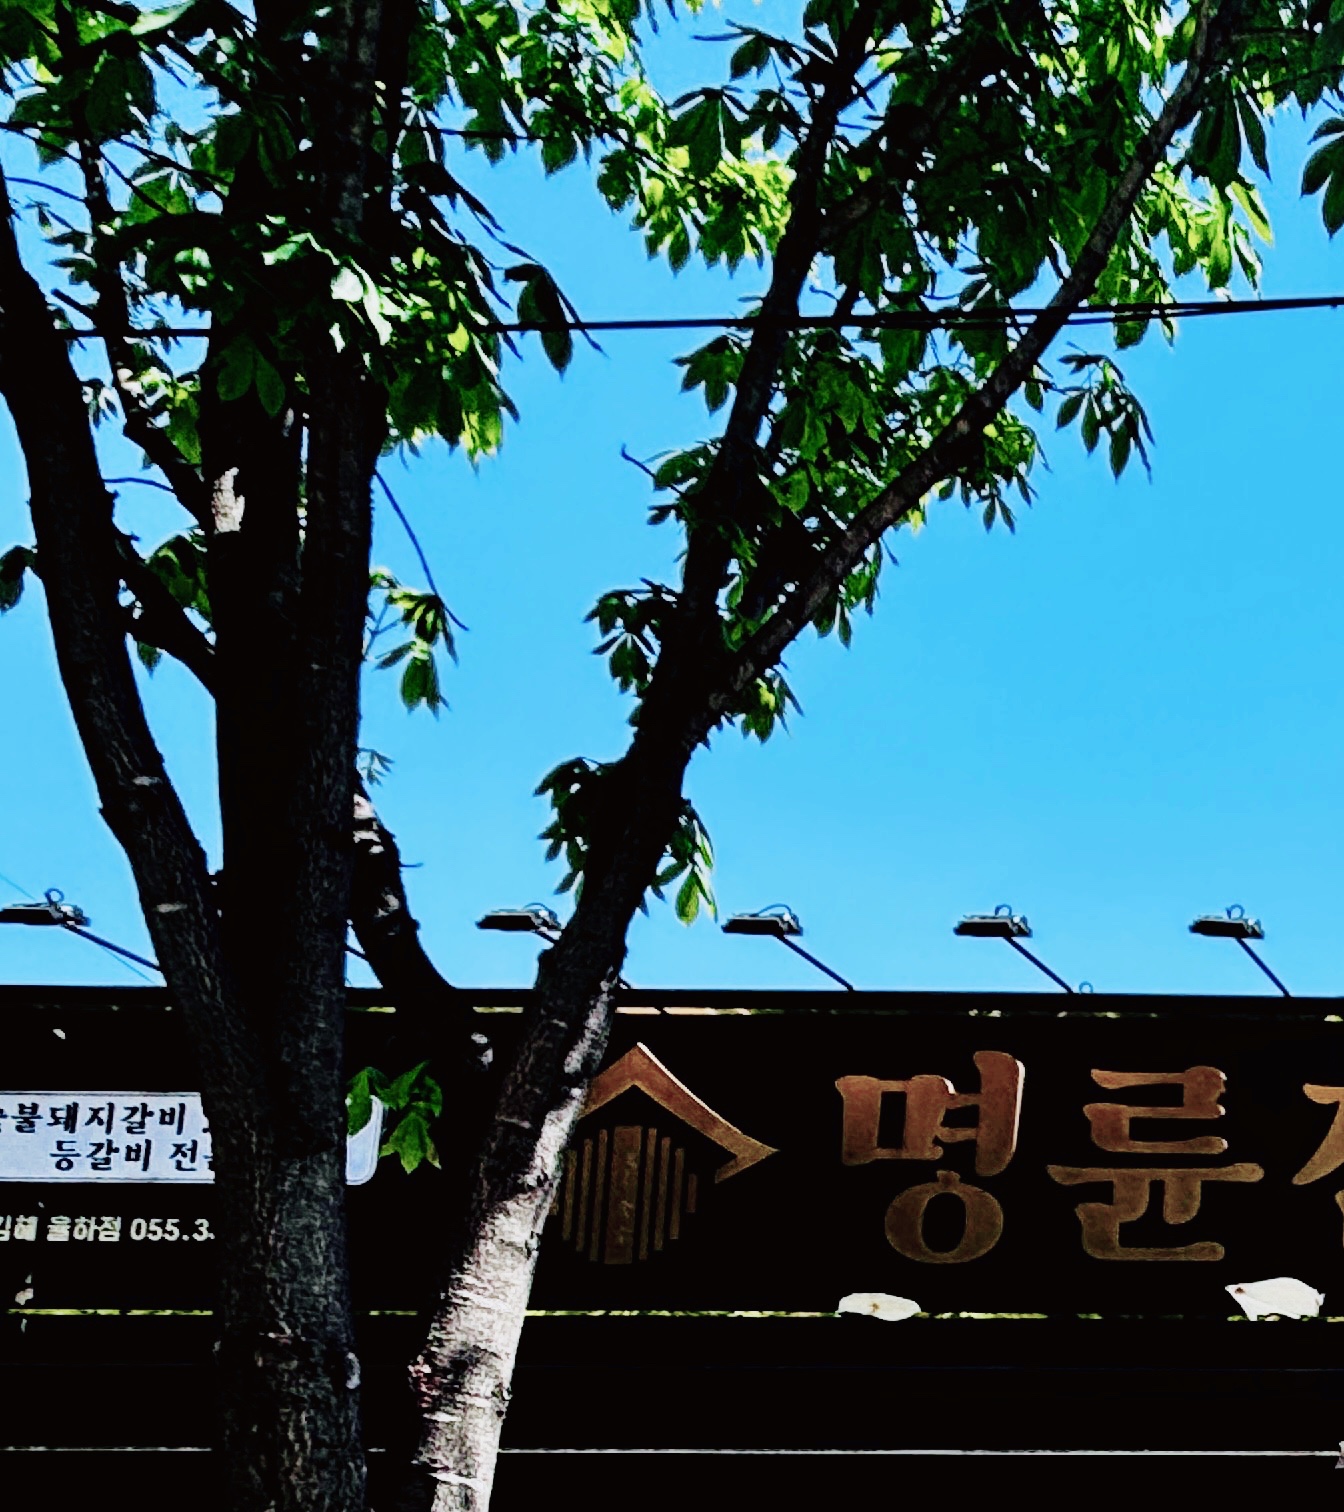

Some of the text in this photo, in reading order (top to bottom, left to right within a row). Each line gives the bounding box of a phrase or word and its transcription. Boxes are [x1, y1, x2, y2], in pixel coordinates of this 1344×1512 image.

[0, 1102, 186, 1135] 불돼지갈비
[49, 1139, 152, 1171] 등갈비
[130, 1218, 216, 1242] 055.3
